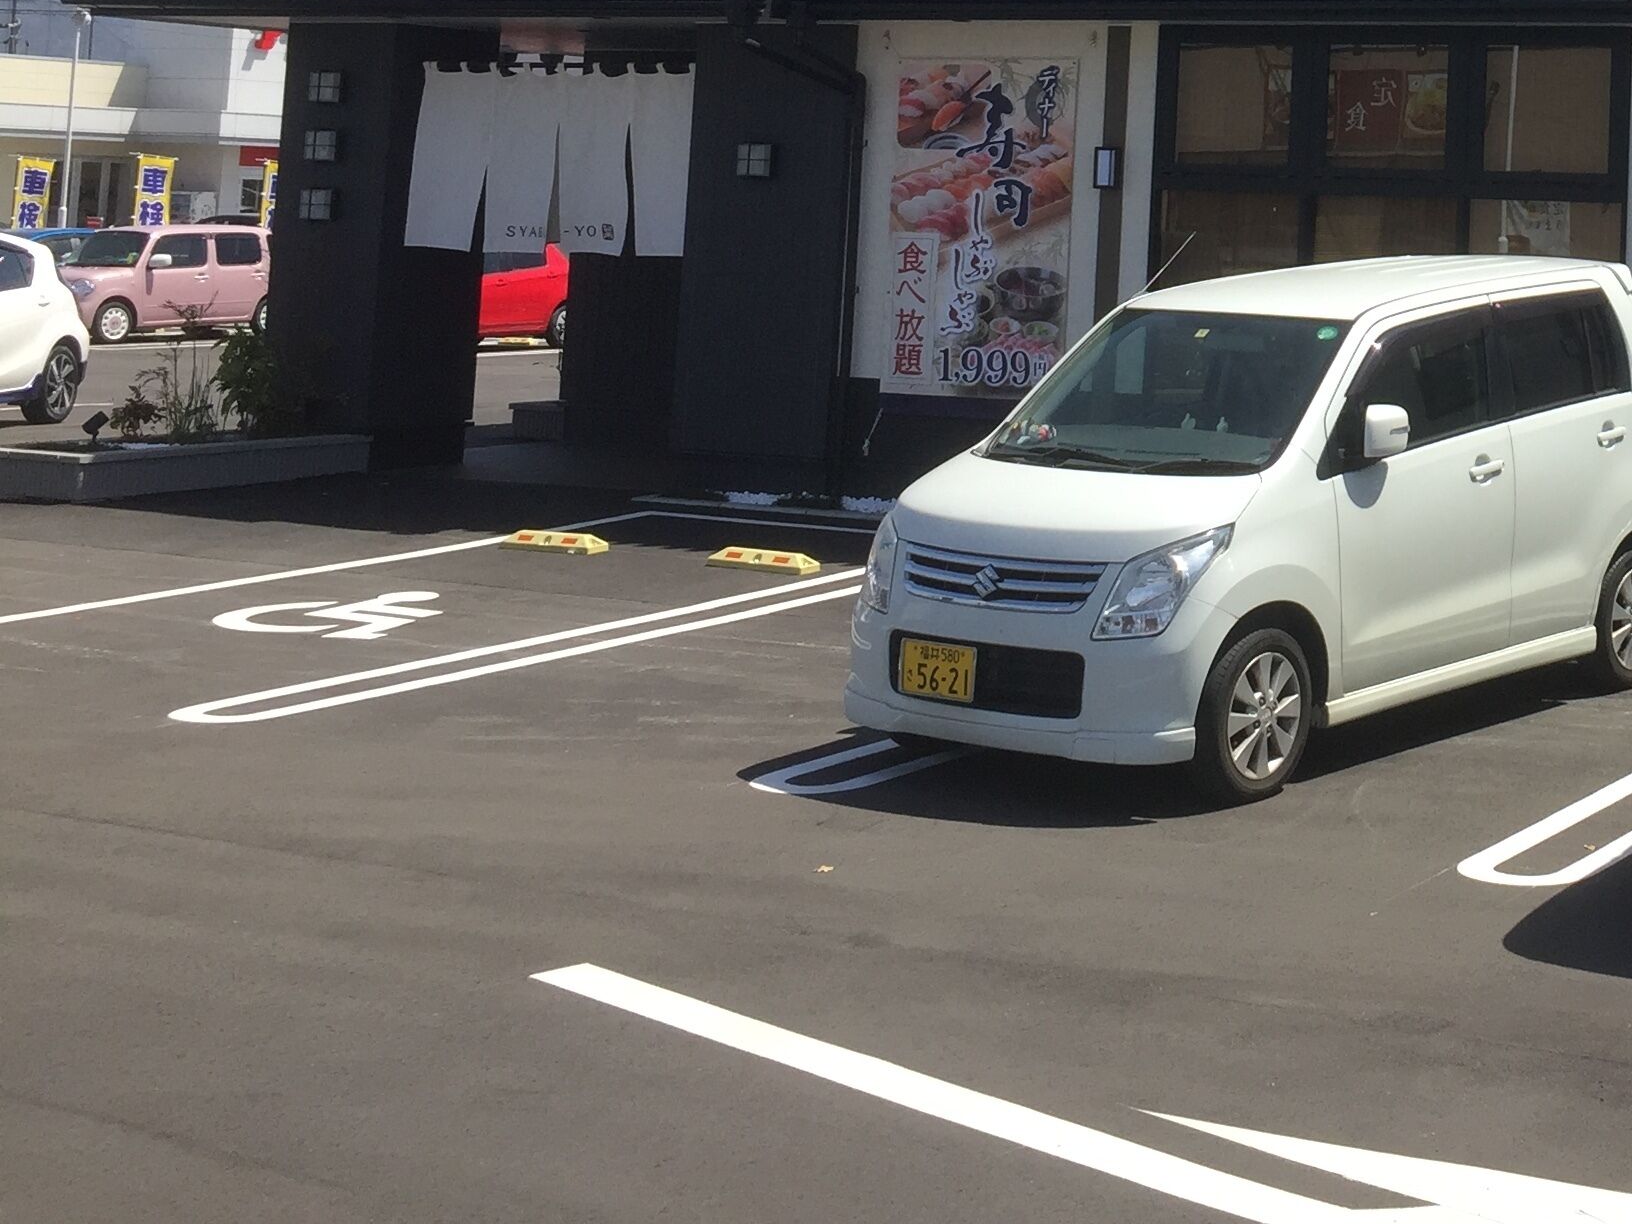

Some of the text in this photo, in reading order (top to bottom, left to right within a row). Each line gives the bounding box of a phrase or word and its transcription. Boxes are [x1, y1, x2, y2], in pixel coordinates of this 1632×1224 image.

[1037, 64, 1059, 139] ディナー
[955, 82, 1032, 228] 寿司
[19, 168, 49, 227] 車検
[138, 166, 169, 226] 車検
[892, 241, 929, 377] 食べ放題
[916, 662, 969, 696] 56-21
